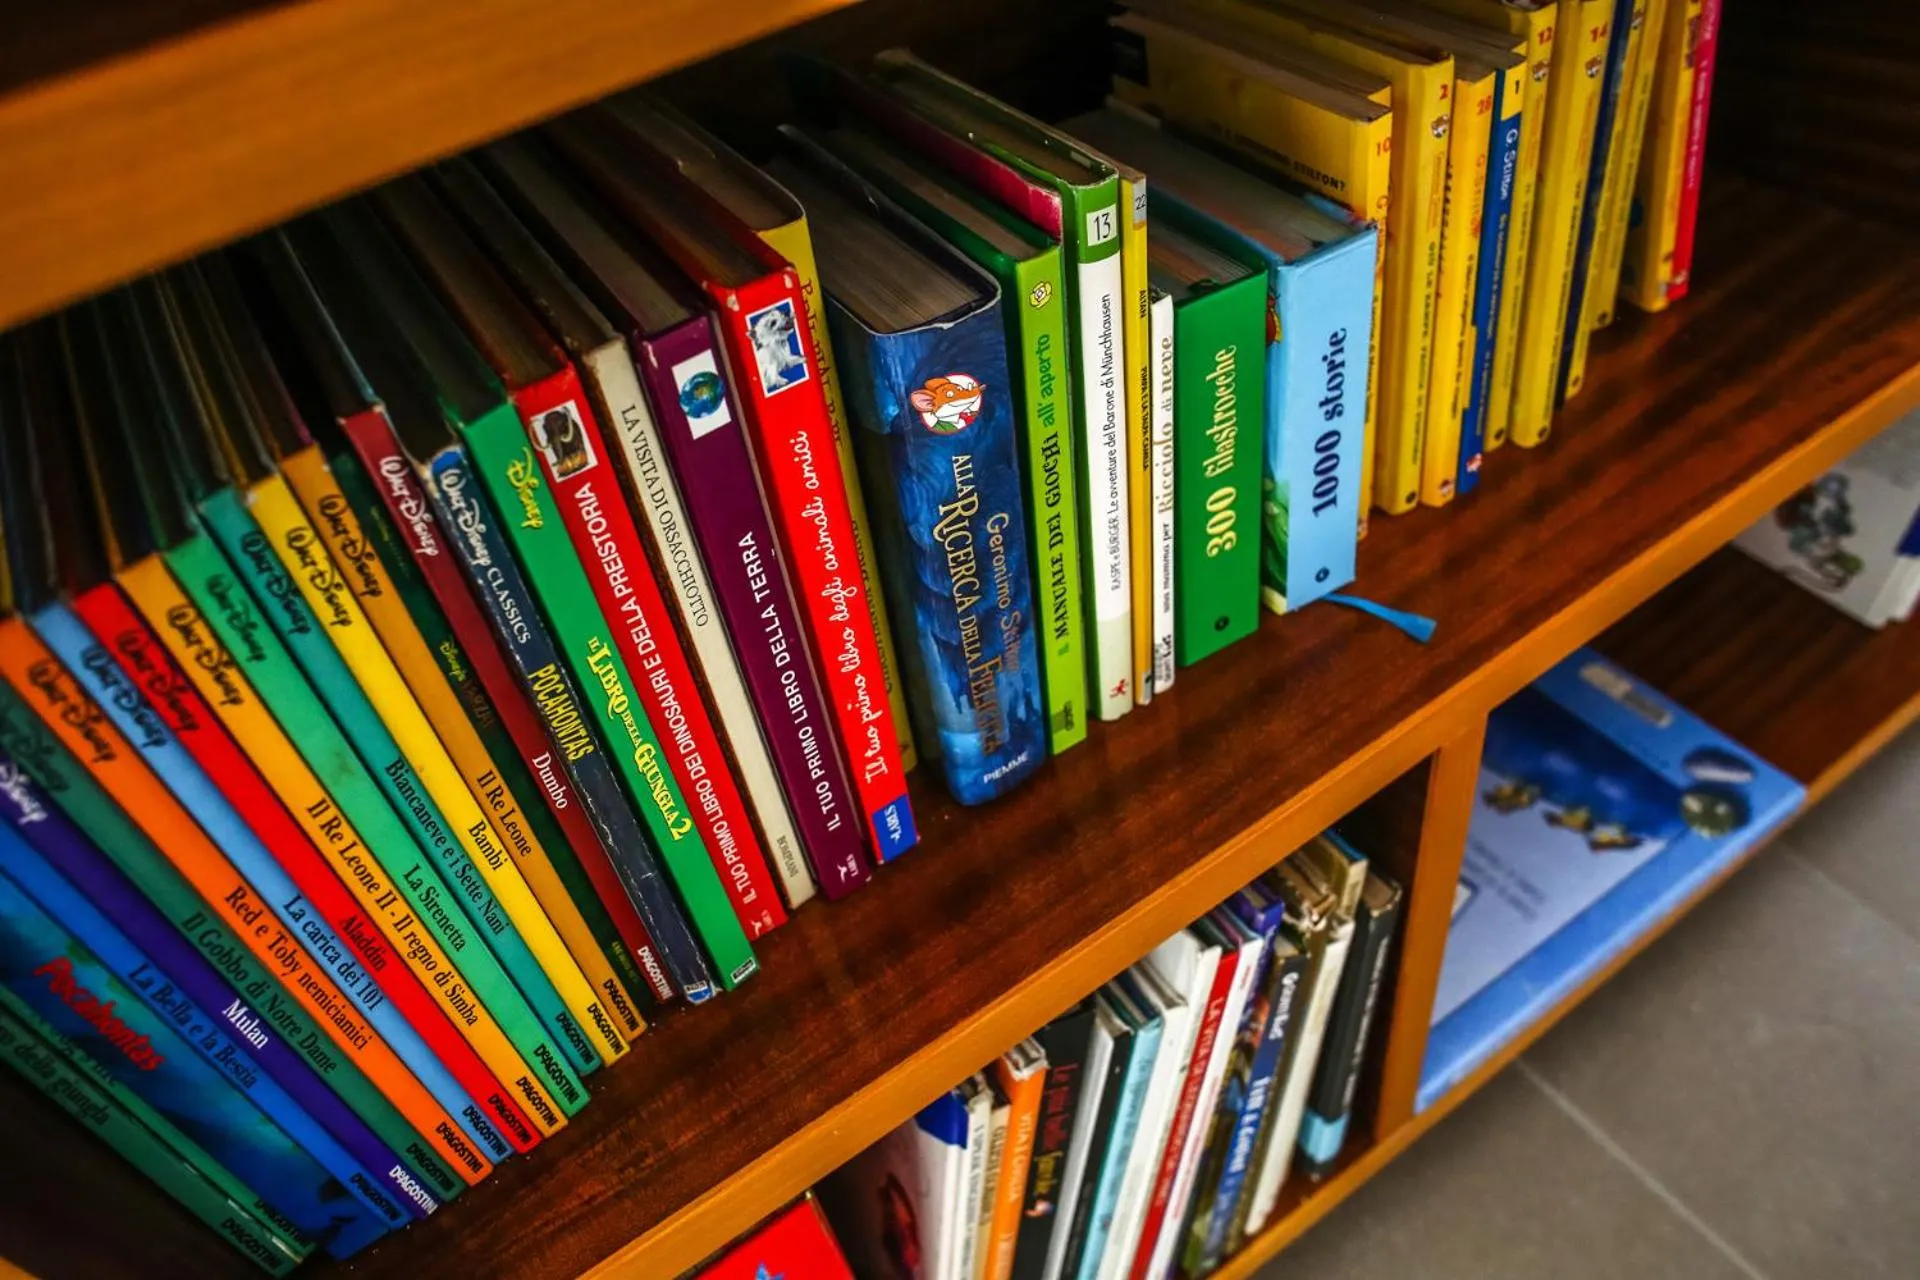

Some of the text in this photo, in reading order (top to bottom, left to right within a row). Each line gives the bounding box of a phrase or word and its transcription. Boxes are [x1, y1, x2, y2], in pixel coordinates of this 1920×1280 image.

[1376, 137, 1392, 156] 10
[1505, 128, 1518, 148] G.
[1501, 149, 1517, 200] Stilton
[1093, 213, 1112, 242] 13
[1098, 294, 1113, 378] Münchhausen
[1161, 336, 1174, 392] neve
[1100, 376, 1115, 391] di
[1103, 392, 1116, 432] Barone
[1161, 398, 1172, 412] di
[1104, 431, 1117, 448] del
[1203, 345, 1238, 558] 300 filastrocche
[1312, 328, 1348, 518] 1000 storie
[789, 430, 821, 489] amici
[1040, 431, 1063, 508] GIOCHI
[1107, 449, 1120, 500] avventure
[1153, 421, 1173, 514] Ricciolo
[379, 456, 410, 497] Walt
[398, 488, 439, 558] Disney
[505, 446, 545, 531] Disney
[621, 405, 709, 628] LA VISITA DI ORSACCHIOTTO
[1107, 501, 1120, 515] Le
[318, 494, 383, 597] Walt Disney
[440, 468, 532, 645] Walt Disney CLASSICS
[801, 496, 839, 571] animali
[932, 454, 983, 664] ALLA RICERCA DELLA
[1046, 511, 1065, 551] DEI
[286, 526, 353, 627] Walt Disney
[986, 512, 1013, 609] Geronimo
[821, 576, 859, 624] degli
[1050, 552, 1071, 641] MANUALE
[838, 627, 862, 673] libro
[574, 482, 759, 905] IL TUO PRIMO LIBRO DEI DINOSAURI E DELLA PREISTORIA
[738, 531, 843, 833] IL TUO PRIMO LIBRO DELLA TERRA
[854, 674, 884, 725] primo
[527, 662, 596, 761] POCAHONTAS
[587, 643, 629, 720] LIBRO
[620, 709, 645, 748] DELLA
[634, 743, 681, 828] GIUNGLA
[671, 817, 693, 841] 2
[864, 725, 882, 758] tuo
[983, 752, 1030, 785] PIEMME
[531, 751, 569, 810] Dumbo
[864, 756, 889, 785] Il
[307, 797, 332, 820] Il
[319, 813, 345, 844] Re
[476, 769, 533, 858] Il Re Leone
[338, 841, 382, 894] Leone
[384, 758, 448, 849] Biancaneve
[443, 847, 454, 861] e
[456, 861, 485, 904] Sette
[477, 901, 511, 937] Nani
[468, 819, 509, 872] Bambi
[375, 890, 399, 911] II
[393, 913, 415, 933] Il
[402, 862, 467, 953] La Sirenetta
[225, 886, 373, 1051] Red e Toby nemiciamici
[283, 893, 386, 1012] La carica dei 101
[340, 915, 388, 973] Aladdin
[402, 930, 439, 971] regno
[181, 911, 338, 1075] Il Gobbo di Notre Dame
[433, 970, 457, 990] di
[444, 982, 480, 1027] Simba
[221, 998, 270, 1049] Mulan
